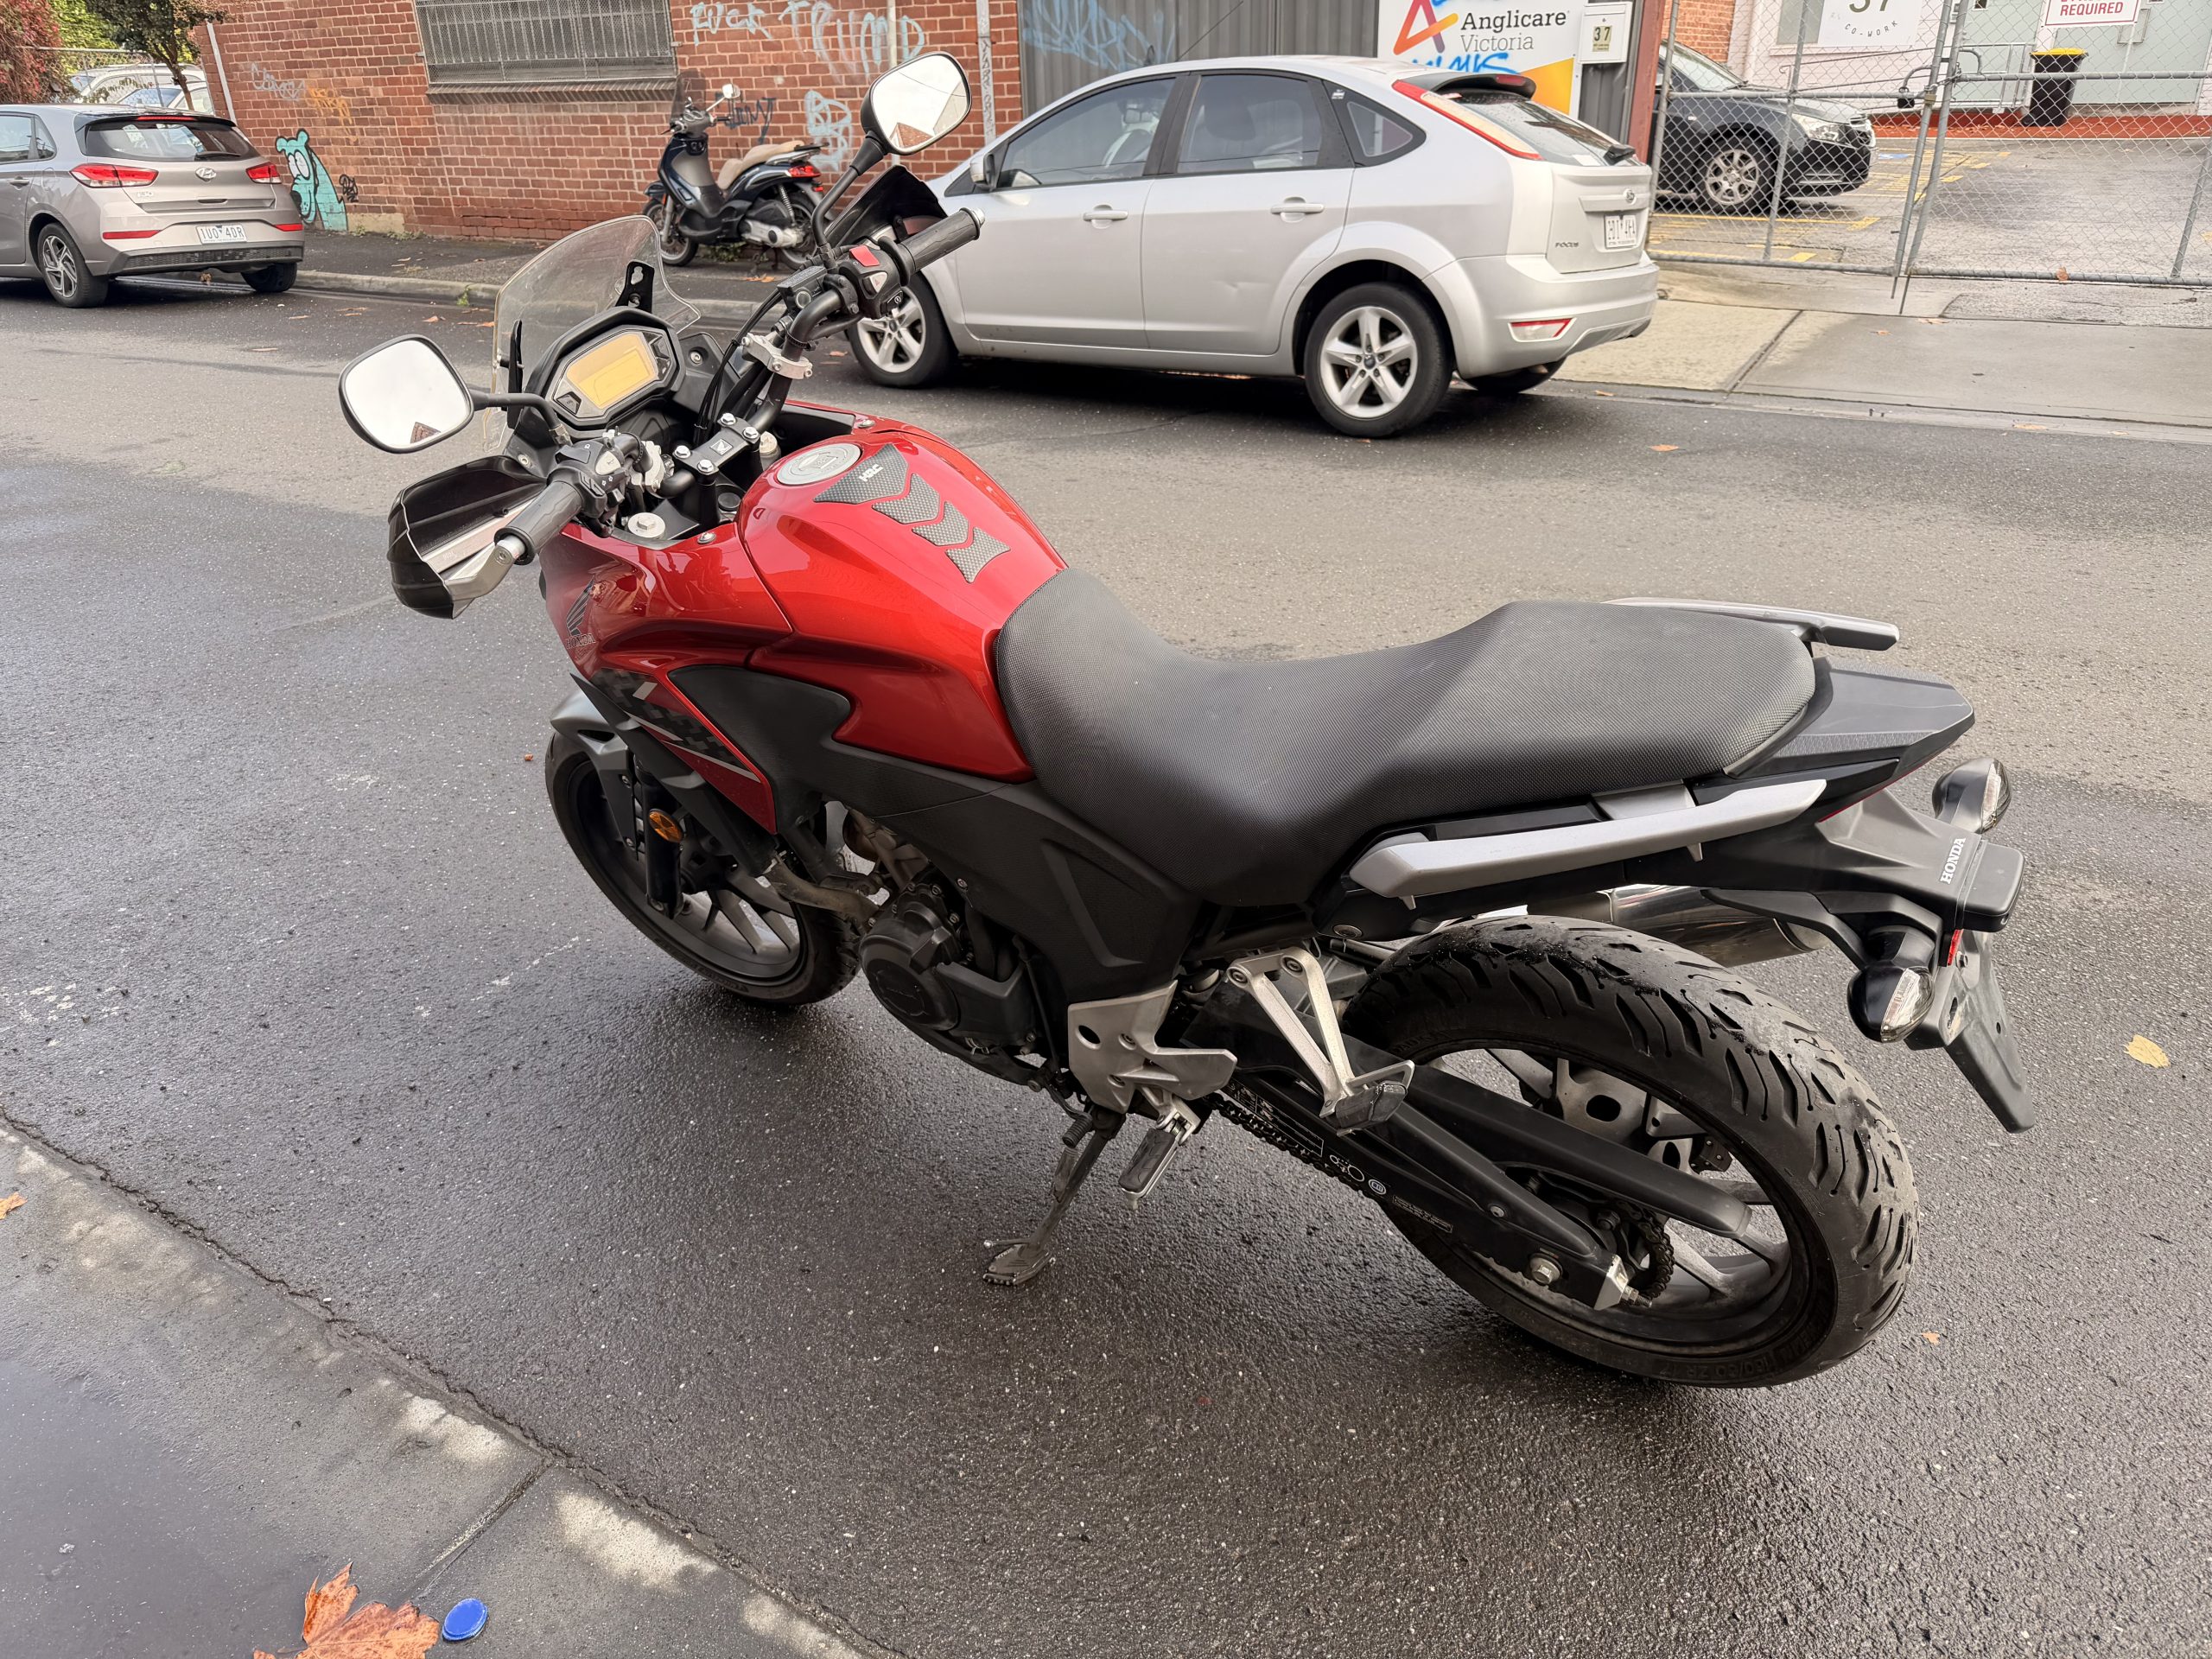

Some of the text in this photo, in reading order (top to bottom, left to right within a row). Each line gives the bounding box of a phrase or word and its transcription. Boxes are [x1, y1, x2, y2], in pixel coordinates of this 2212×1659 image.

[2060, 2, 2124, 16] REQUIRED
[1460, 10, 1567, 34] Anglicare
[1460, 33, 1535, 53] Victoria
[1594, 27, 1611, 41] 37
[566, 632, 596, 650] HONDA
[1939, 837, 1967, 885] HONDA
